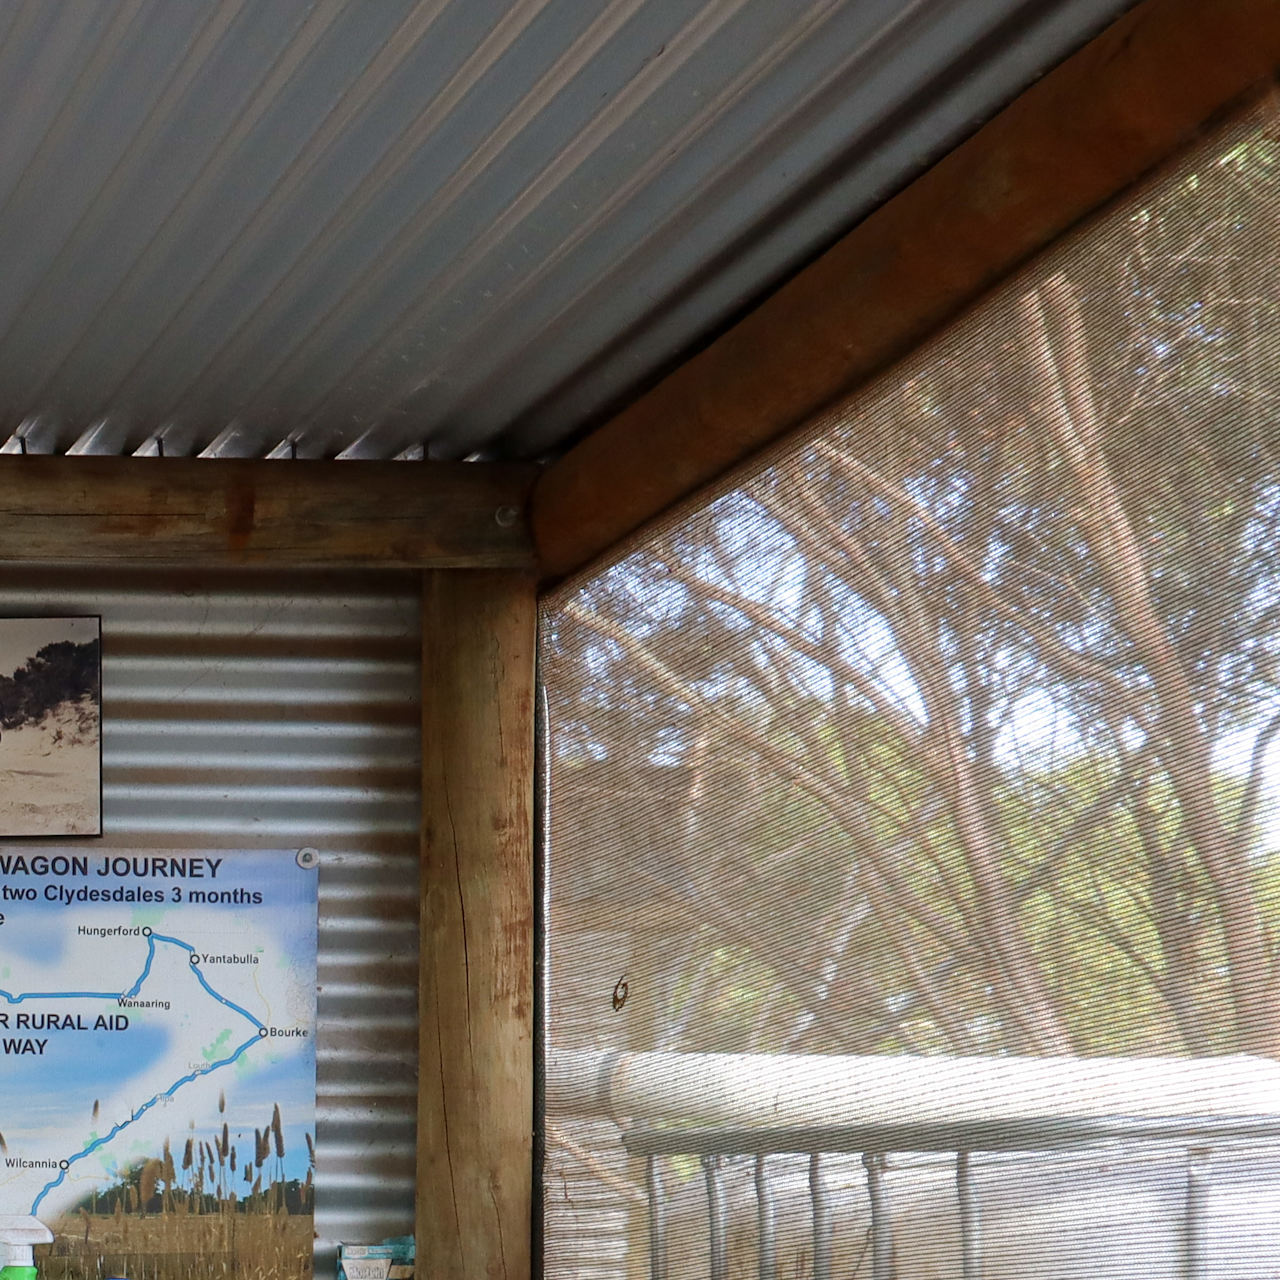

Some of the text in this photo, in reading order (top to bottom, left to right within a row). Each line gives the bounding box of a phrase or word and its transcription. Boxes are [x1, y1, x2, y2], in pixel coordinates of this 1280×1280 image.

[96, 857, 223, 879] JOURNEY
[2, 885, 38, 902] two
[44, 884, 165, 906] Clydesdales
[170, 886, 183, 903] 3
[188, 887, 263, 905] months
[77, 924, 140, 938] Hungerford
[202, 954, 259, 965] Yantabulla
[117, 998, 170, 1010] Wanaaring
[16, 1012, 90, 1032] RURAL
[93, 1014, 130, 1032] AID
[270, 1026, 308, 1038] Bourke
[2, 1038, 49, 1056] WAY
[5, 1158, 58, 1170] Wilcannia
